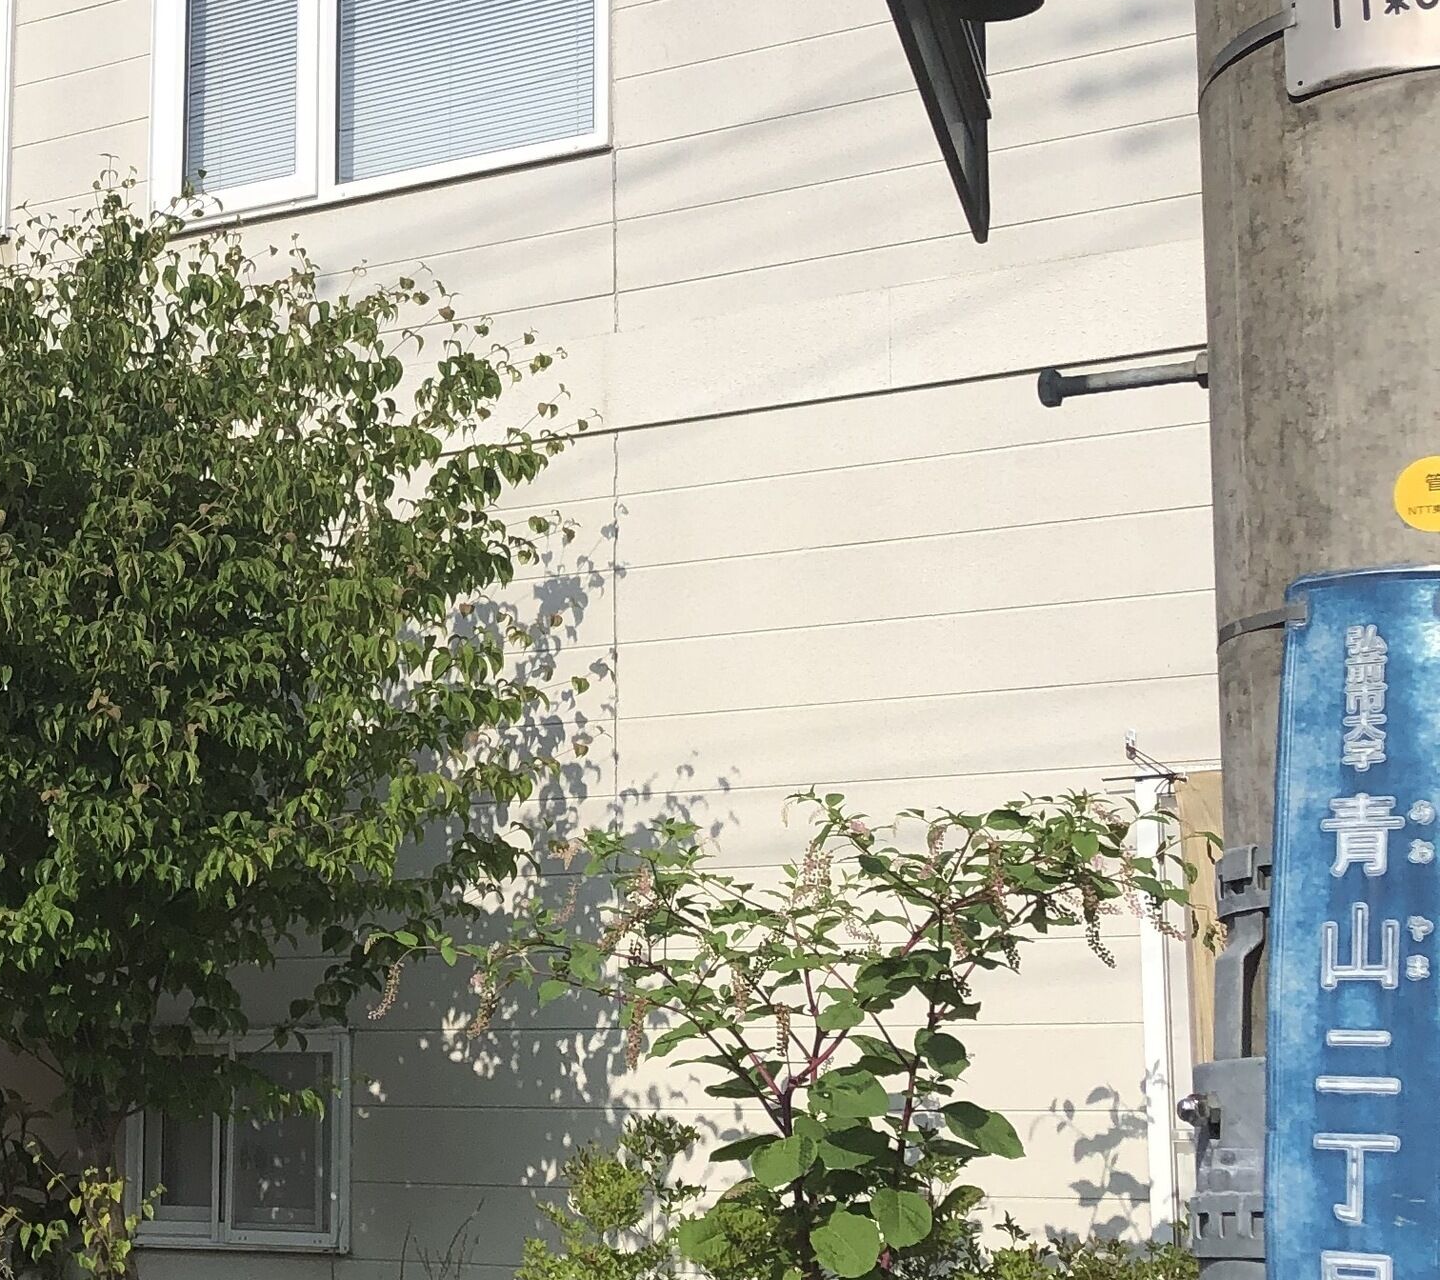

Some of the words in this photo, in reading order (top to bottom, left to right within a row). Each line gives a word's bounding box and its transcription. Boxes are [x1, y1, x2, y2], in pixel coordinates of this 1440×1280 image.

[1342, 624, 1388, 772] 弘前市大字
